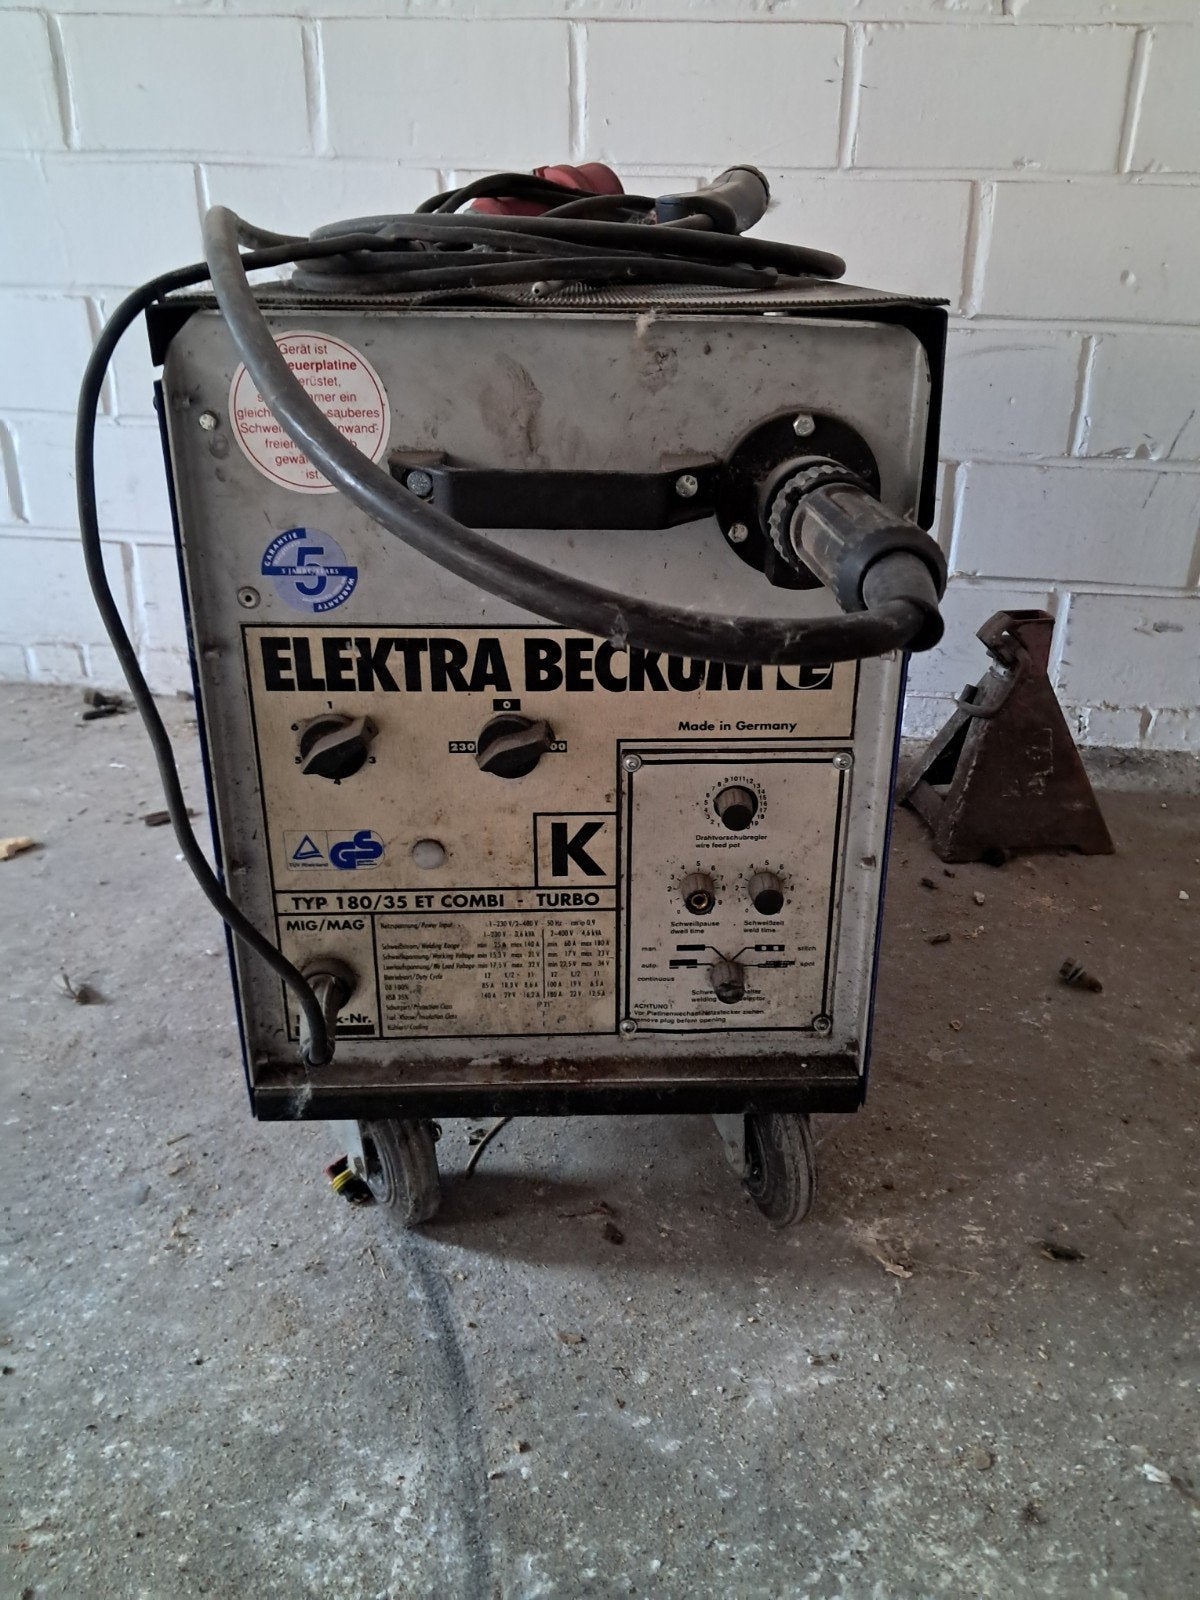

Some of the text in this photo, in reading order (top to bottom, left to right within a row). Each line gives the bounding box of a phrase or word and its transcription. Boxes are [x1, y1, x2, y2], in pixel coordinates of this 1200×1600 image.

[279, 343, 328, 355] Gerät ist
[288, 360, 357, 373] euerplatine
[300, 376, 341, 388] erüstet,
[340, 393, 357, 402] ein
[237, 408, 380, 422] gleich sauberes
[240, 423, 283, 434] Schwei
[263, 531, 299, 567] GARANTIE
[295, 546, 327, 596] 5
[317, 578, 355, 610] WARRANTY
[260, 637, 513, 692] ELEKTRA
[524, 638, 763, 693] BECKUM
[327, 701, 333, 709] 1
[678, 720, 798, 734] Made in Germany
[450, 742, 476, 752] 230
[550, 742, 567, 751] 00
[368, 756, 377, 764] 3
[551, 822, 607, 877] K
[291, 893, 600, 911] TYP 180/35 ET COMBI TURBO
[286, 919, 365, 932] MIG/MAG
